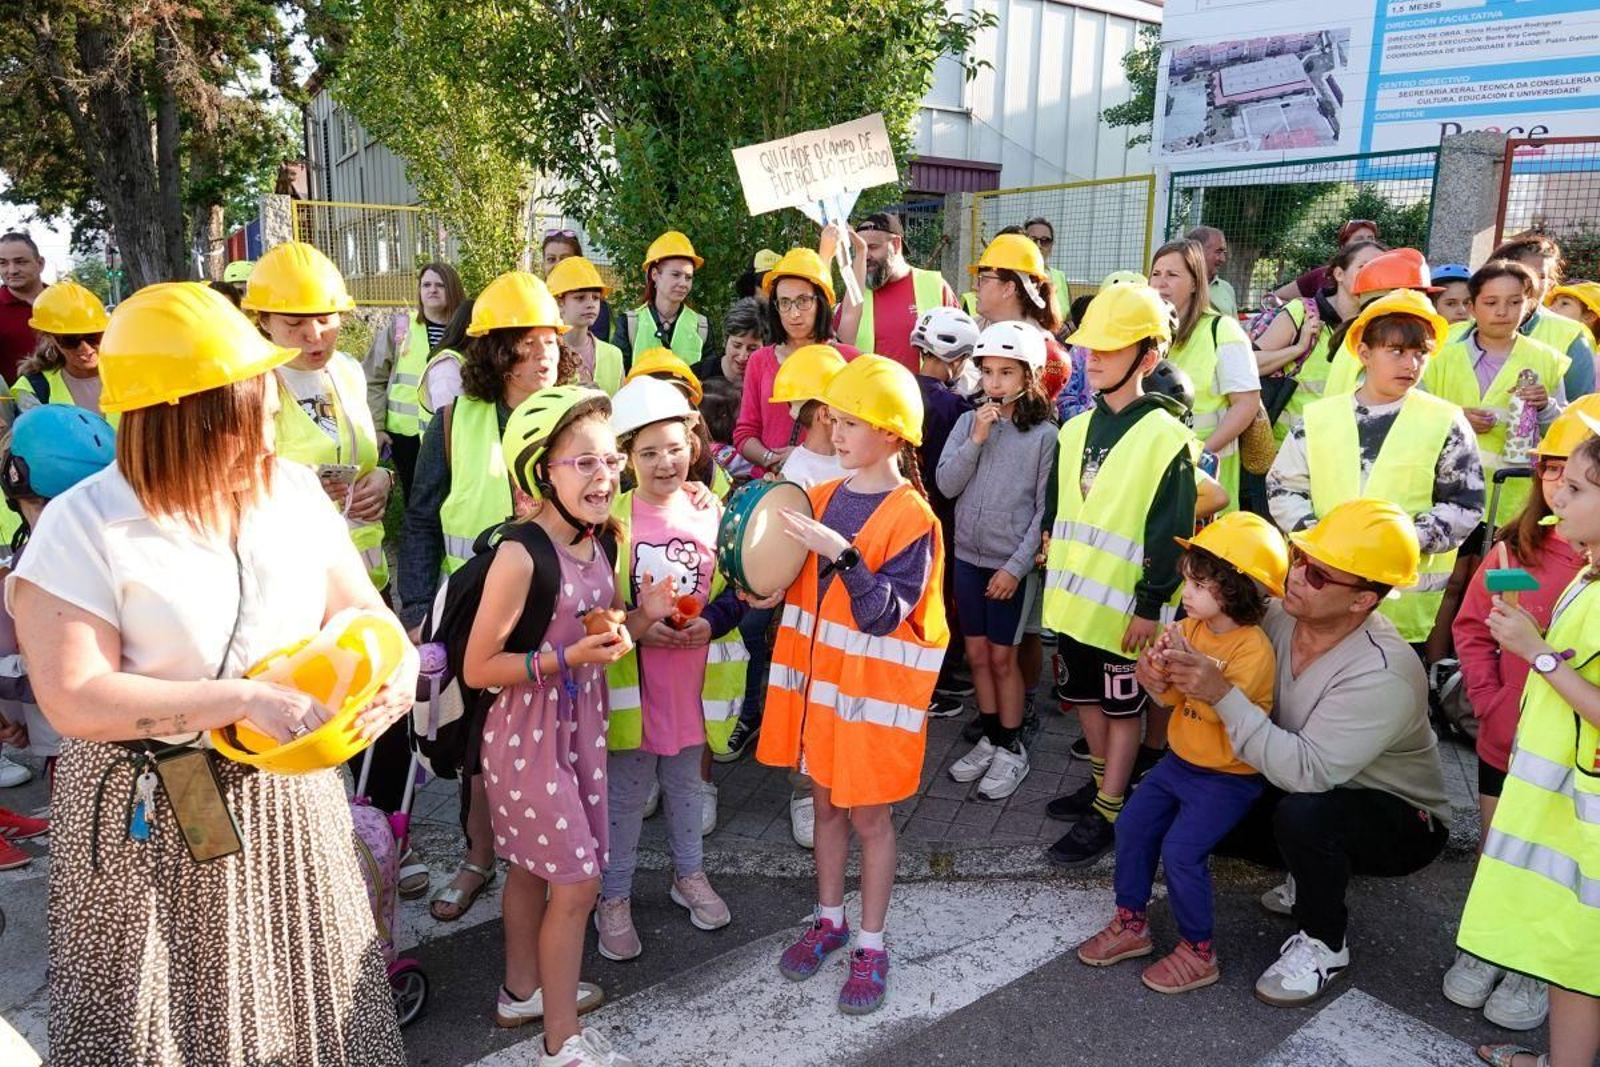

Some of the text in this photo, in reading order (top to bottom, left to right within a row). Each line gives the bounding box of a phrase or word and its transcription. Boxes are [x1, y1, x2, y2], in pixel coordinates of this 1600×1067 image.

[1408, 1, 1442, 12] MESES
[1439, 10, 1503, 25] FACULTATIVA
[1379, 76, 1469, 89] CENTRO DIRECTIVO
[1398, 86, 1448, 98] SECRETARÍA
[1449, 85, 1476, 94] XERAL
[1516, 81, 1528, 89] DA
[1530, 75, 1592, 87] CONSELLERÍA
[1517, 86, 1581, 98] UNIVERSIDADE
[858, 131, 872, 151] DE
[1103, 662, 1137, 673] MESS
[1104, 672, 1139, 700] 10
